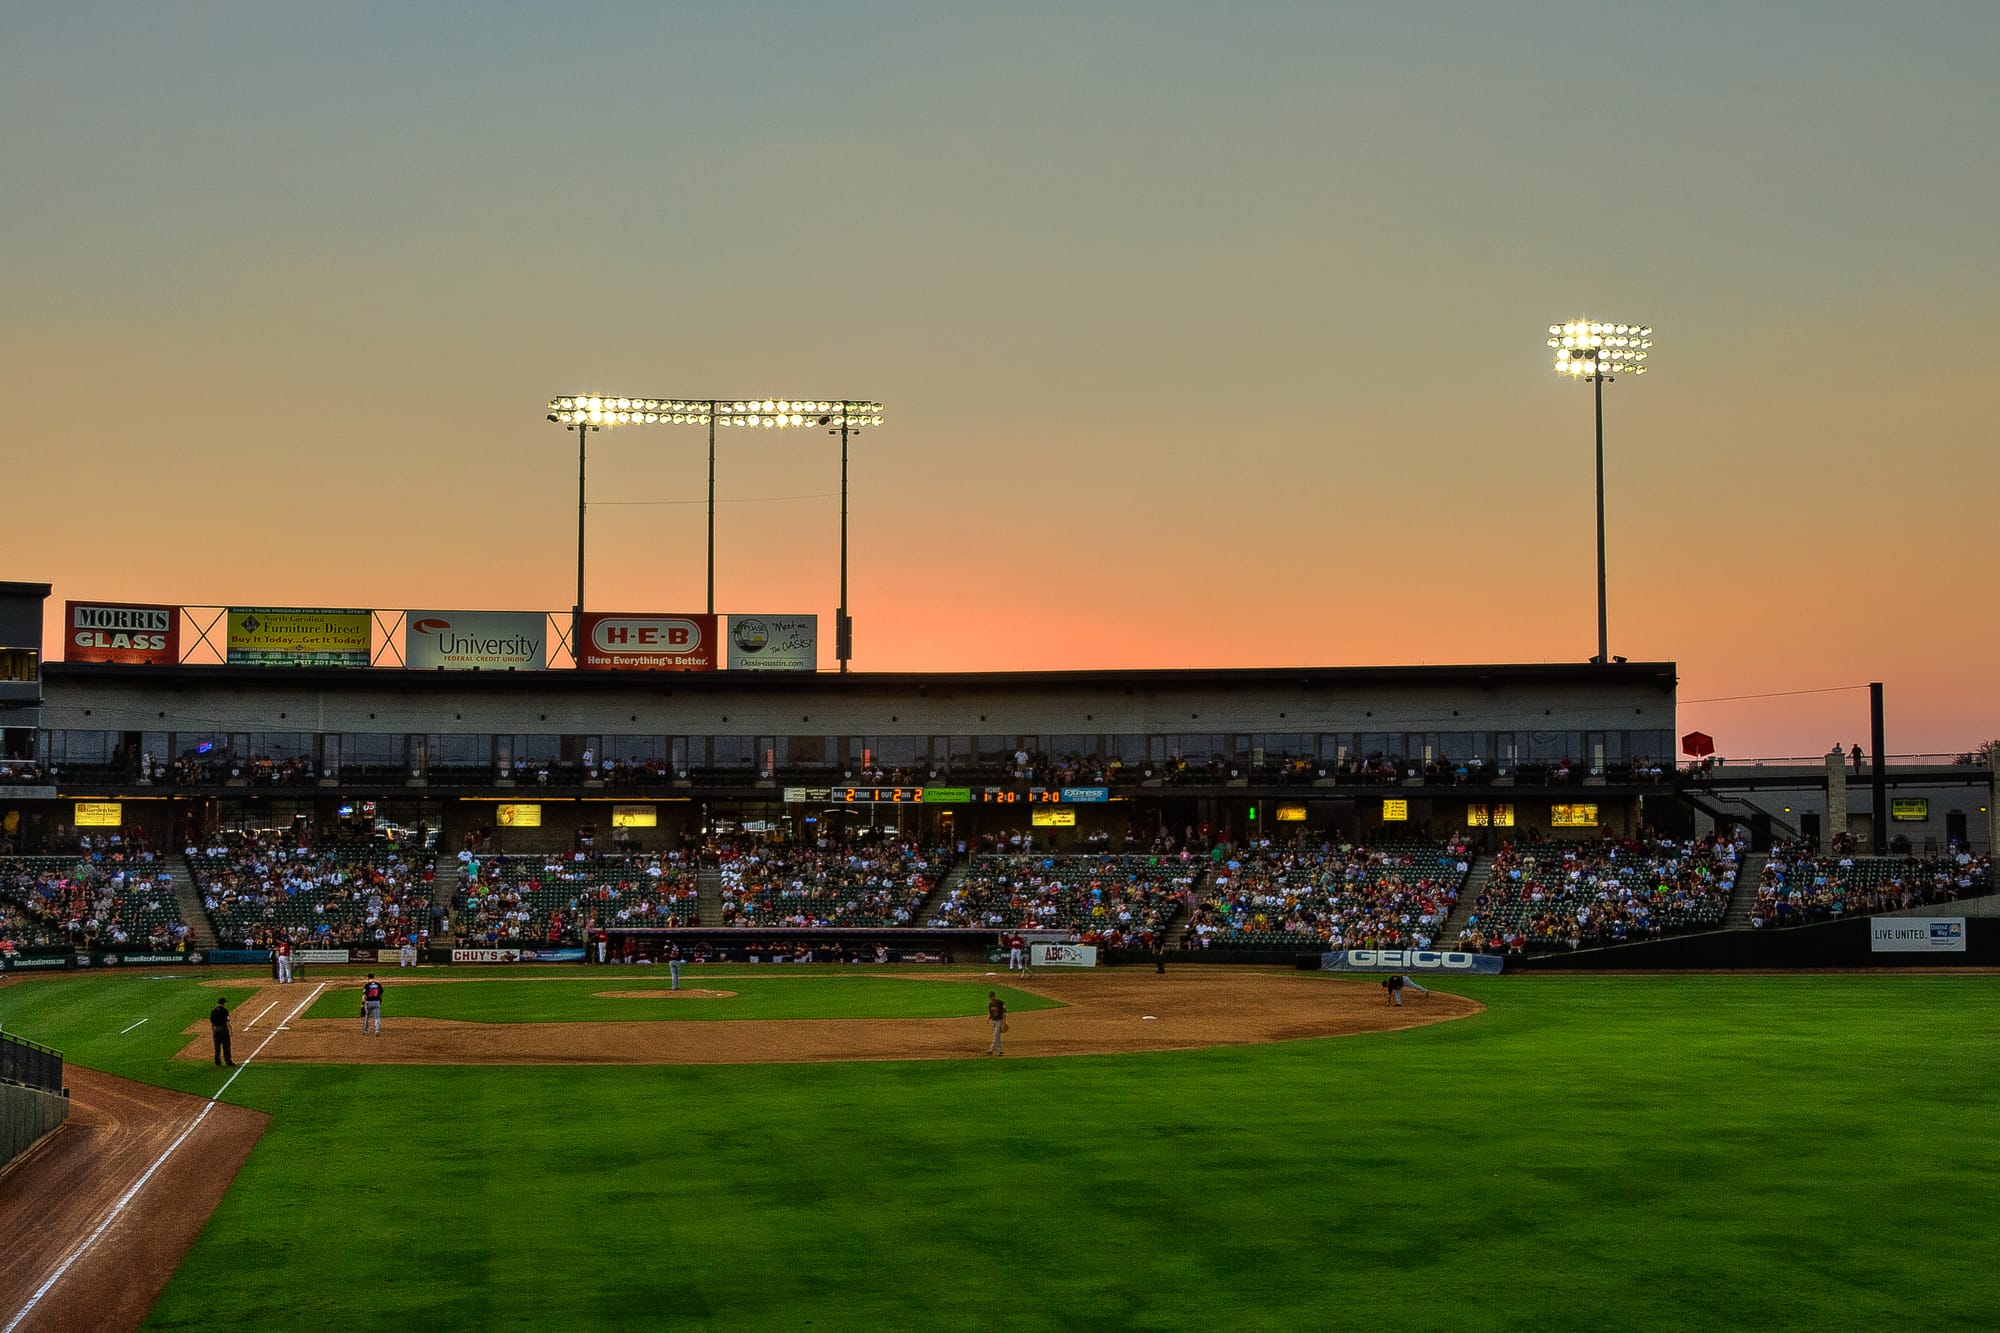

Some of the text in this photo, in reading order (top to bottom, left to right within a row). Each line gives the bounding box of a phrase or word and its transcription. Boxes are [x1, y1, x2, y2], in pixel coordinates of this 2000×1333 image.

[79, 608, 168, 630] MORRIS
[264, 622, 360, 634] Furniture Direct
[74, 631, 167, 650] GLASS
[231, 635, 250, 644] Buy
[333, 636, 366, 645] Today!
[607, 627, 690, 645] H-E-B
[439, 632, 540, 663] University
[588, 656, 611, 665] Here
[613, 656, 673, 666] Everything's
[846, 788, 855, 802] 2
[893, 788, 902, 802] 2
[914, 788, 923, 802] 2
[997, 791, 1004, 803] 2
[1007, 791, 1015, 803] 0
[1041, 791, 1049, 803] 2
[1052, 791, 1060, 803] 0
[1875, 929, 1928, 939] LIVE UNITED.
[454, 951, 498, 961] CHUY'S
[1045, 946, 1063, 961] ABC
[1347, 949, 1474, 968] GEICO
